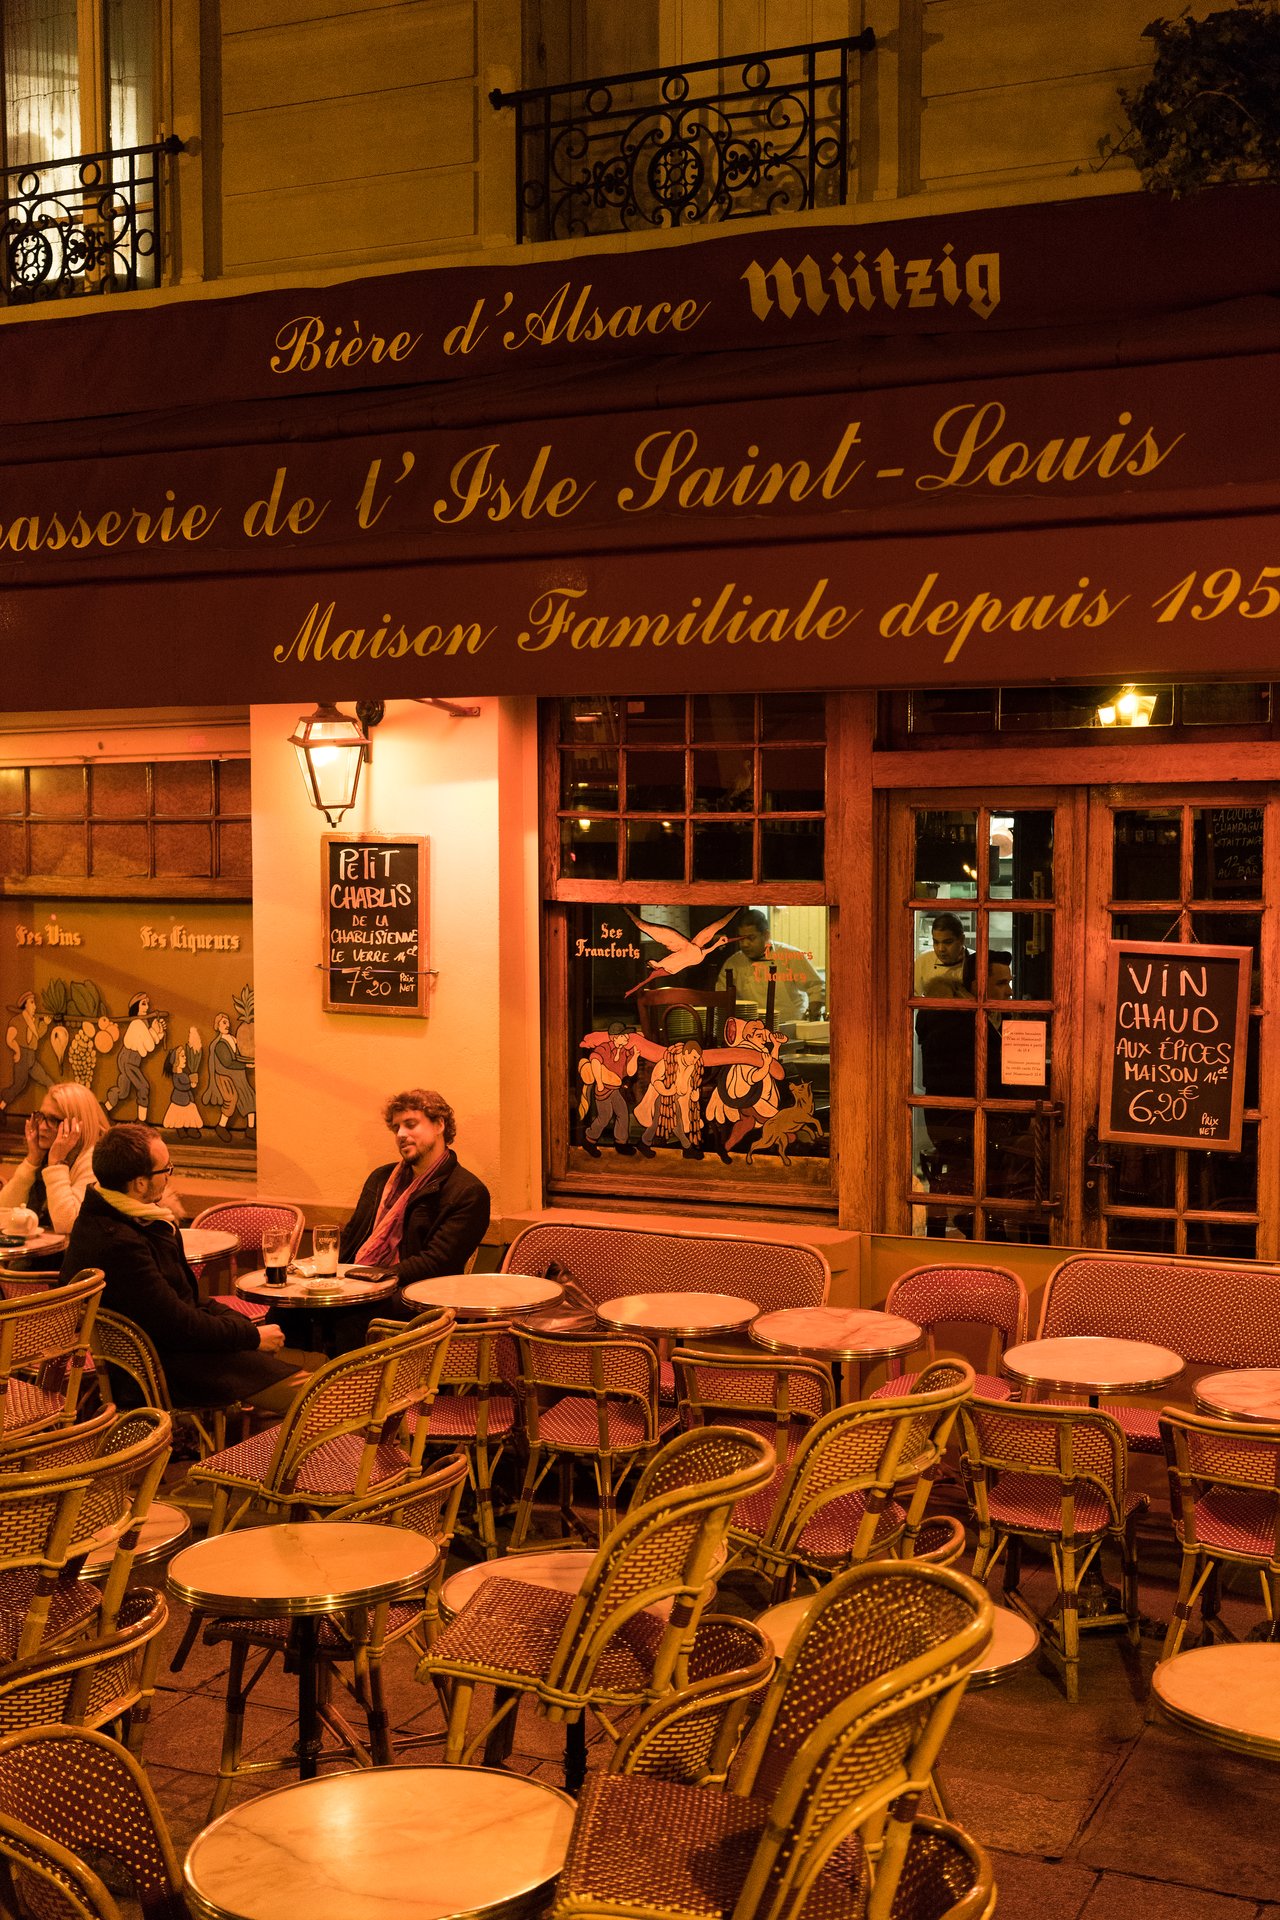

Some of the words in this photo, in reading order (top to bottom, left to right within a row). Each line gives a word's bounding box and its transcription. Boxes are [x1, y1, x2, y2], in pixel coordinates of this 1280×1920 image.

[270, 315, 424, 374] Bière
[0, 490, 222, 552] asserie
[243, 466, 331, 538] de
[273, 601, 498, 664] Maison
[517, 577, 864, 653] Familiale
[878, 572, 1132, 664] depuis
[45, 923, 82, 946] Vins
[352, 914, 368, 927] DE
[375, 914, 389, 927] LA
[169, 924, 240, 953] Liqueurs
[331, 948, 345, 963] LE
[352, 949, 390, 963] VERRE
[1118, 1001, 1219, 1034] CHAUD
[1116, 1037, 1152, 1059] AUX
